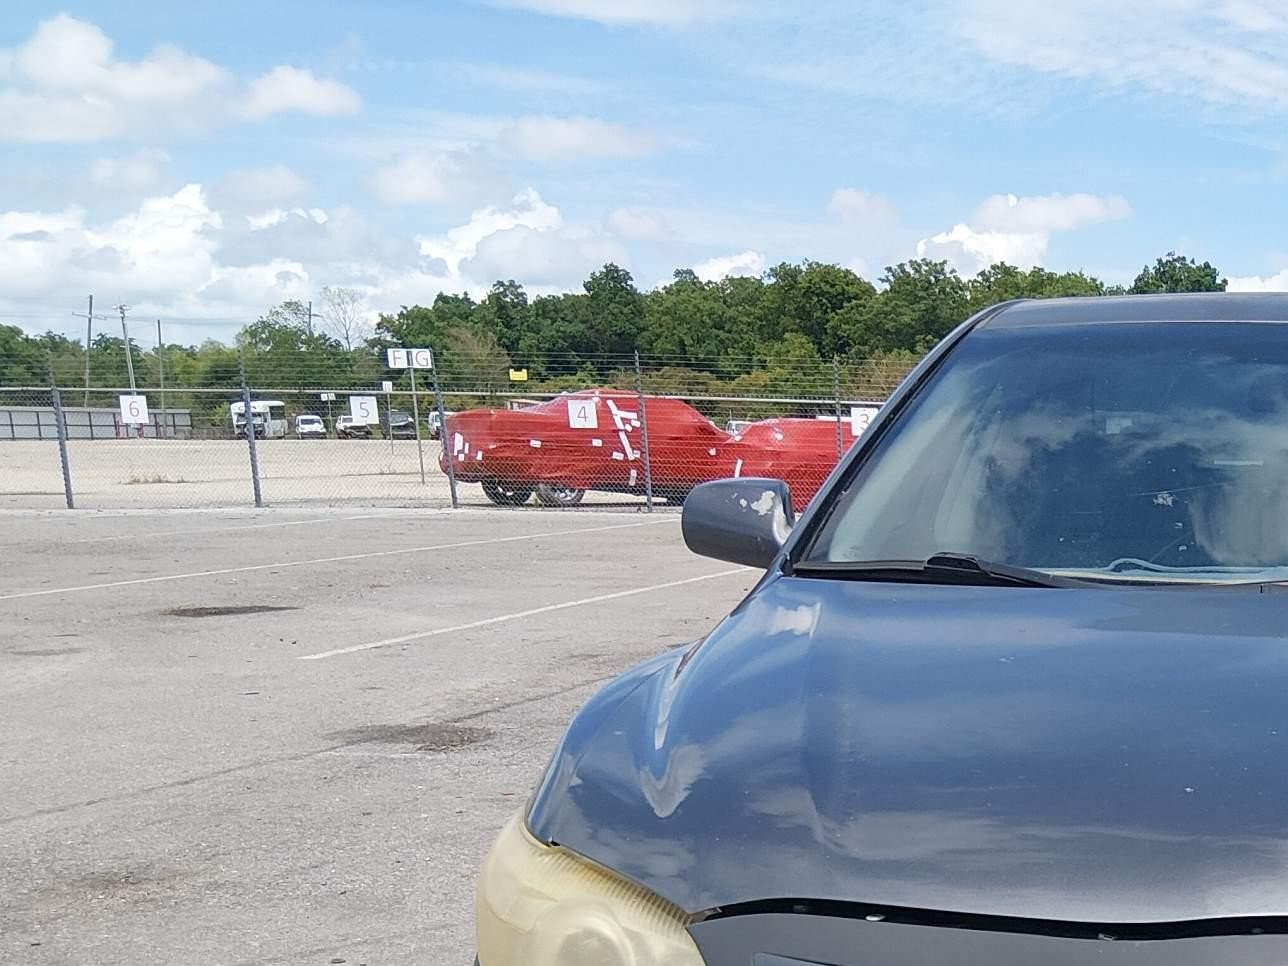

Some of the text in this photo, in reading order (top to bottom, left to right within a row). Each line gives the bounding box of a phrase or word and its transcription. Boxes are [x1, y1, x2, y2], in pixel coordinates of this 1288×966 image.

[392, 350, 402, 367] F
[415, 350, 429, 367] G
[129, 401, 140, 417] 6
[359, 402, 370, 418] 5
[577, 406, 588, 422] 4
